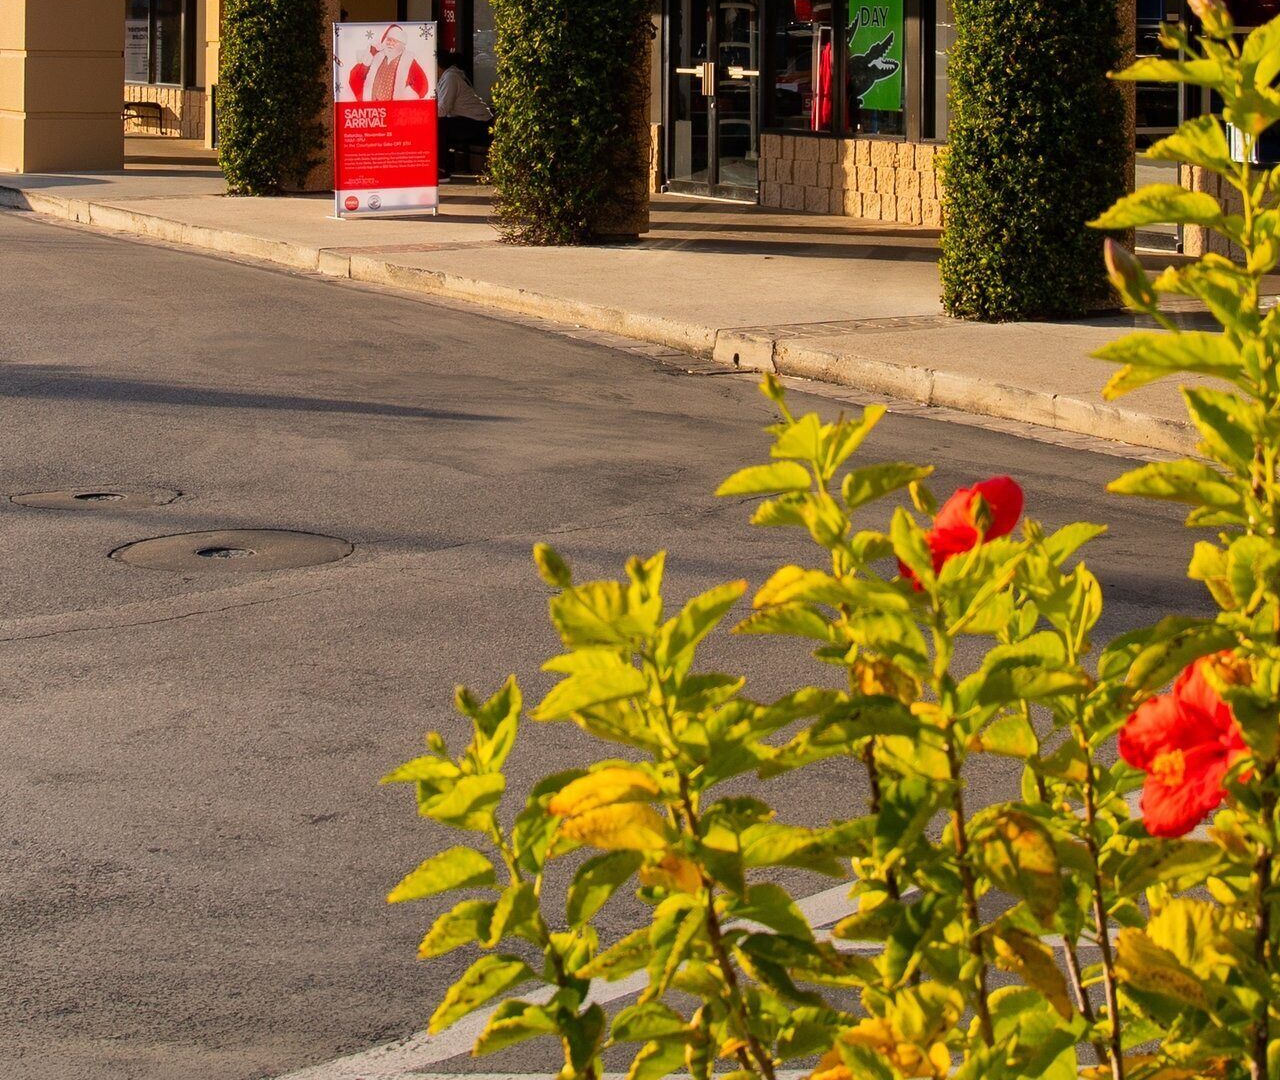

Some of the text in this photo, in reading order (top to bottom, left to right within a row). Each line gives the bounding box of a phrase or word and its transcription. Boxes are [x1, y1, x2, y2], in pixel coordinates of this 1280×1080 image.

[860, 6, 889, 27] DAY
[344, 108, 387, 119] SANTA'S
[344, 118, 387, 129] ARRIVAL
